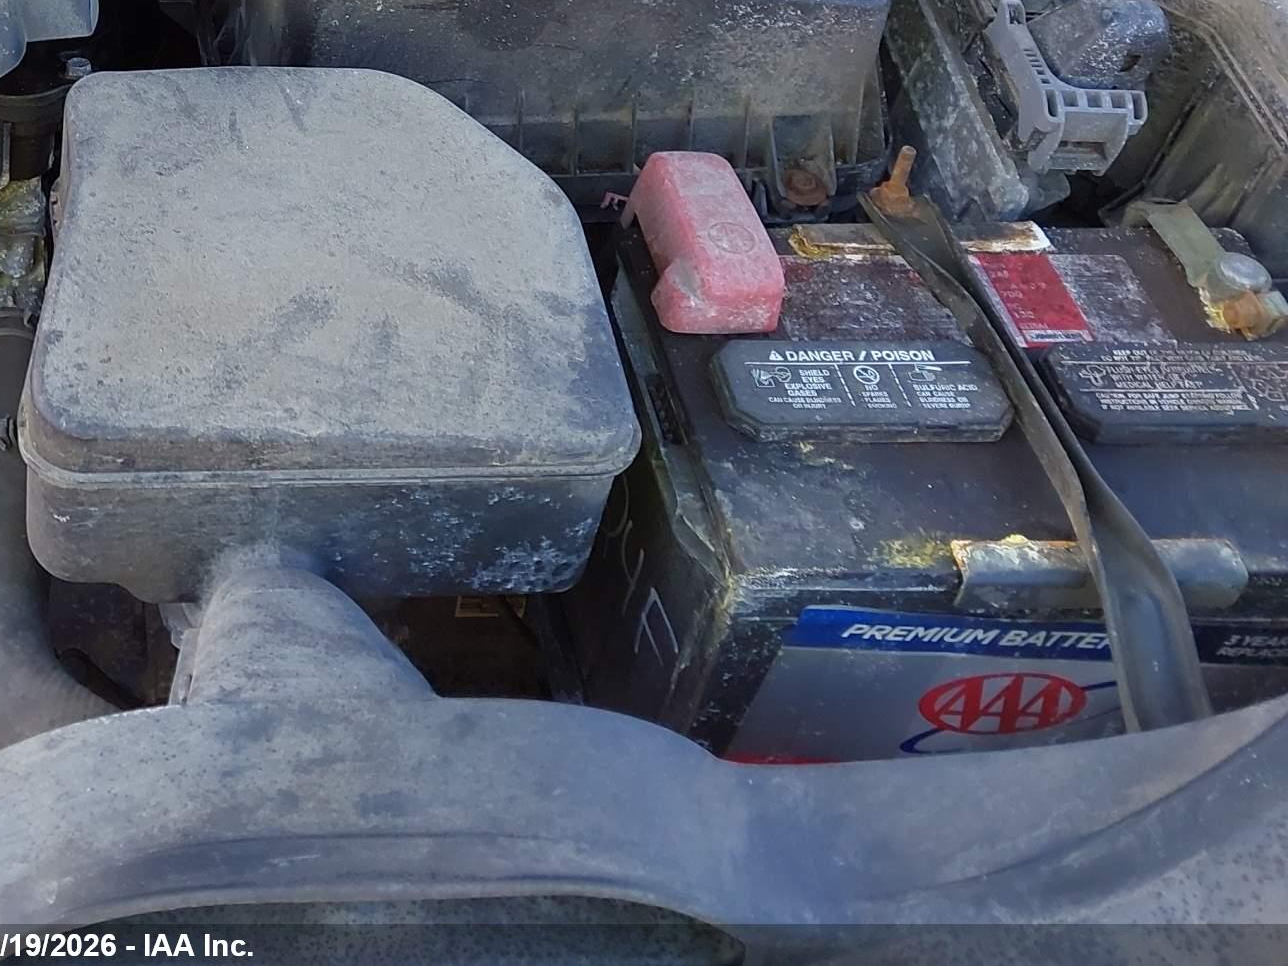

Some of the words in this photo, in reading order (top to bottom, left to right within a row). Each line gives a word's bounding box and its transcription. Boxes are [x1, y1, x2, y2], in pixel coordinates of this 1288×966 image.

[785, 350, 855, 362] DANGER
[858, 350, 867, 362] /
[871, 350, 935, 362] POISON
[841, 623, 1001, 646] PREMIUM
[934, 673, 1064, 734] AAA
